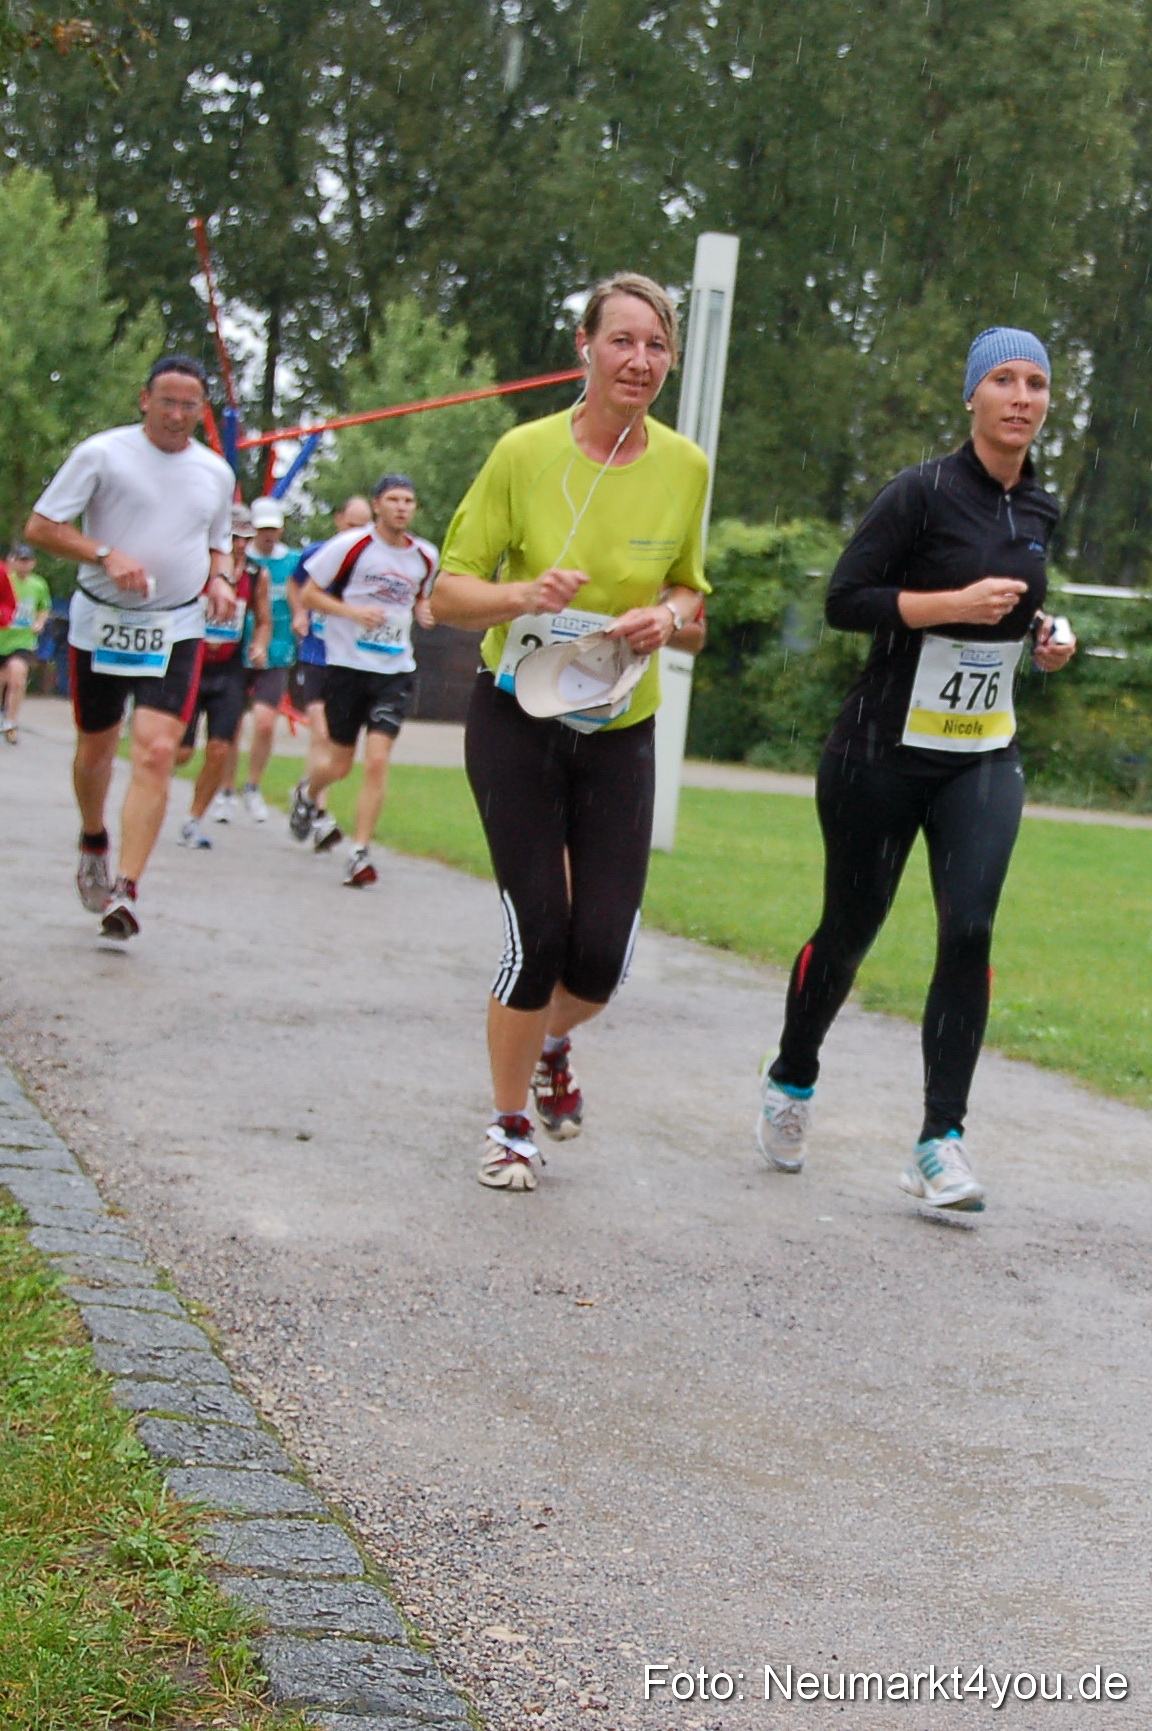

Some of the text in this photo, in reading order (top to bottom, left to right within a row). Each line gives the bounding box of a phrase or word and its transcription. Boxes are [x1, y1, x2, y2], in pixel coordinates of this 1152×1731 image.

[102, 624, 163, 652] 2568
[939, 671, 1000, 710] 476
[943, 719, 983, 736] Nicole
